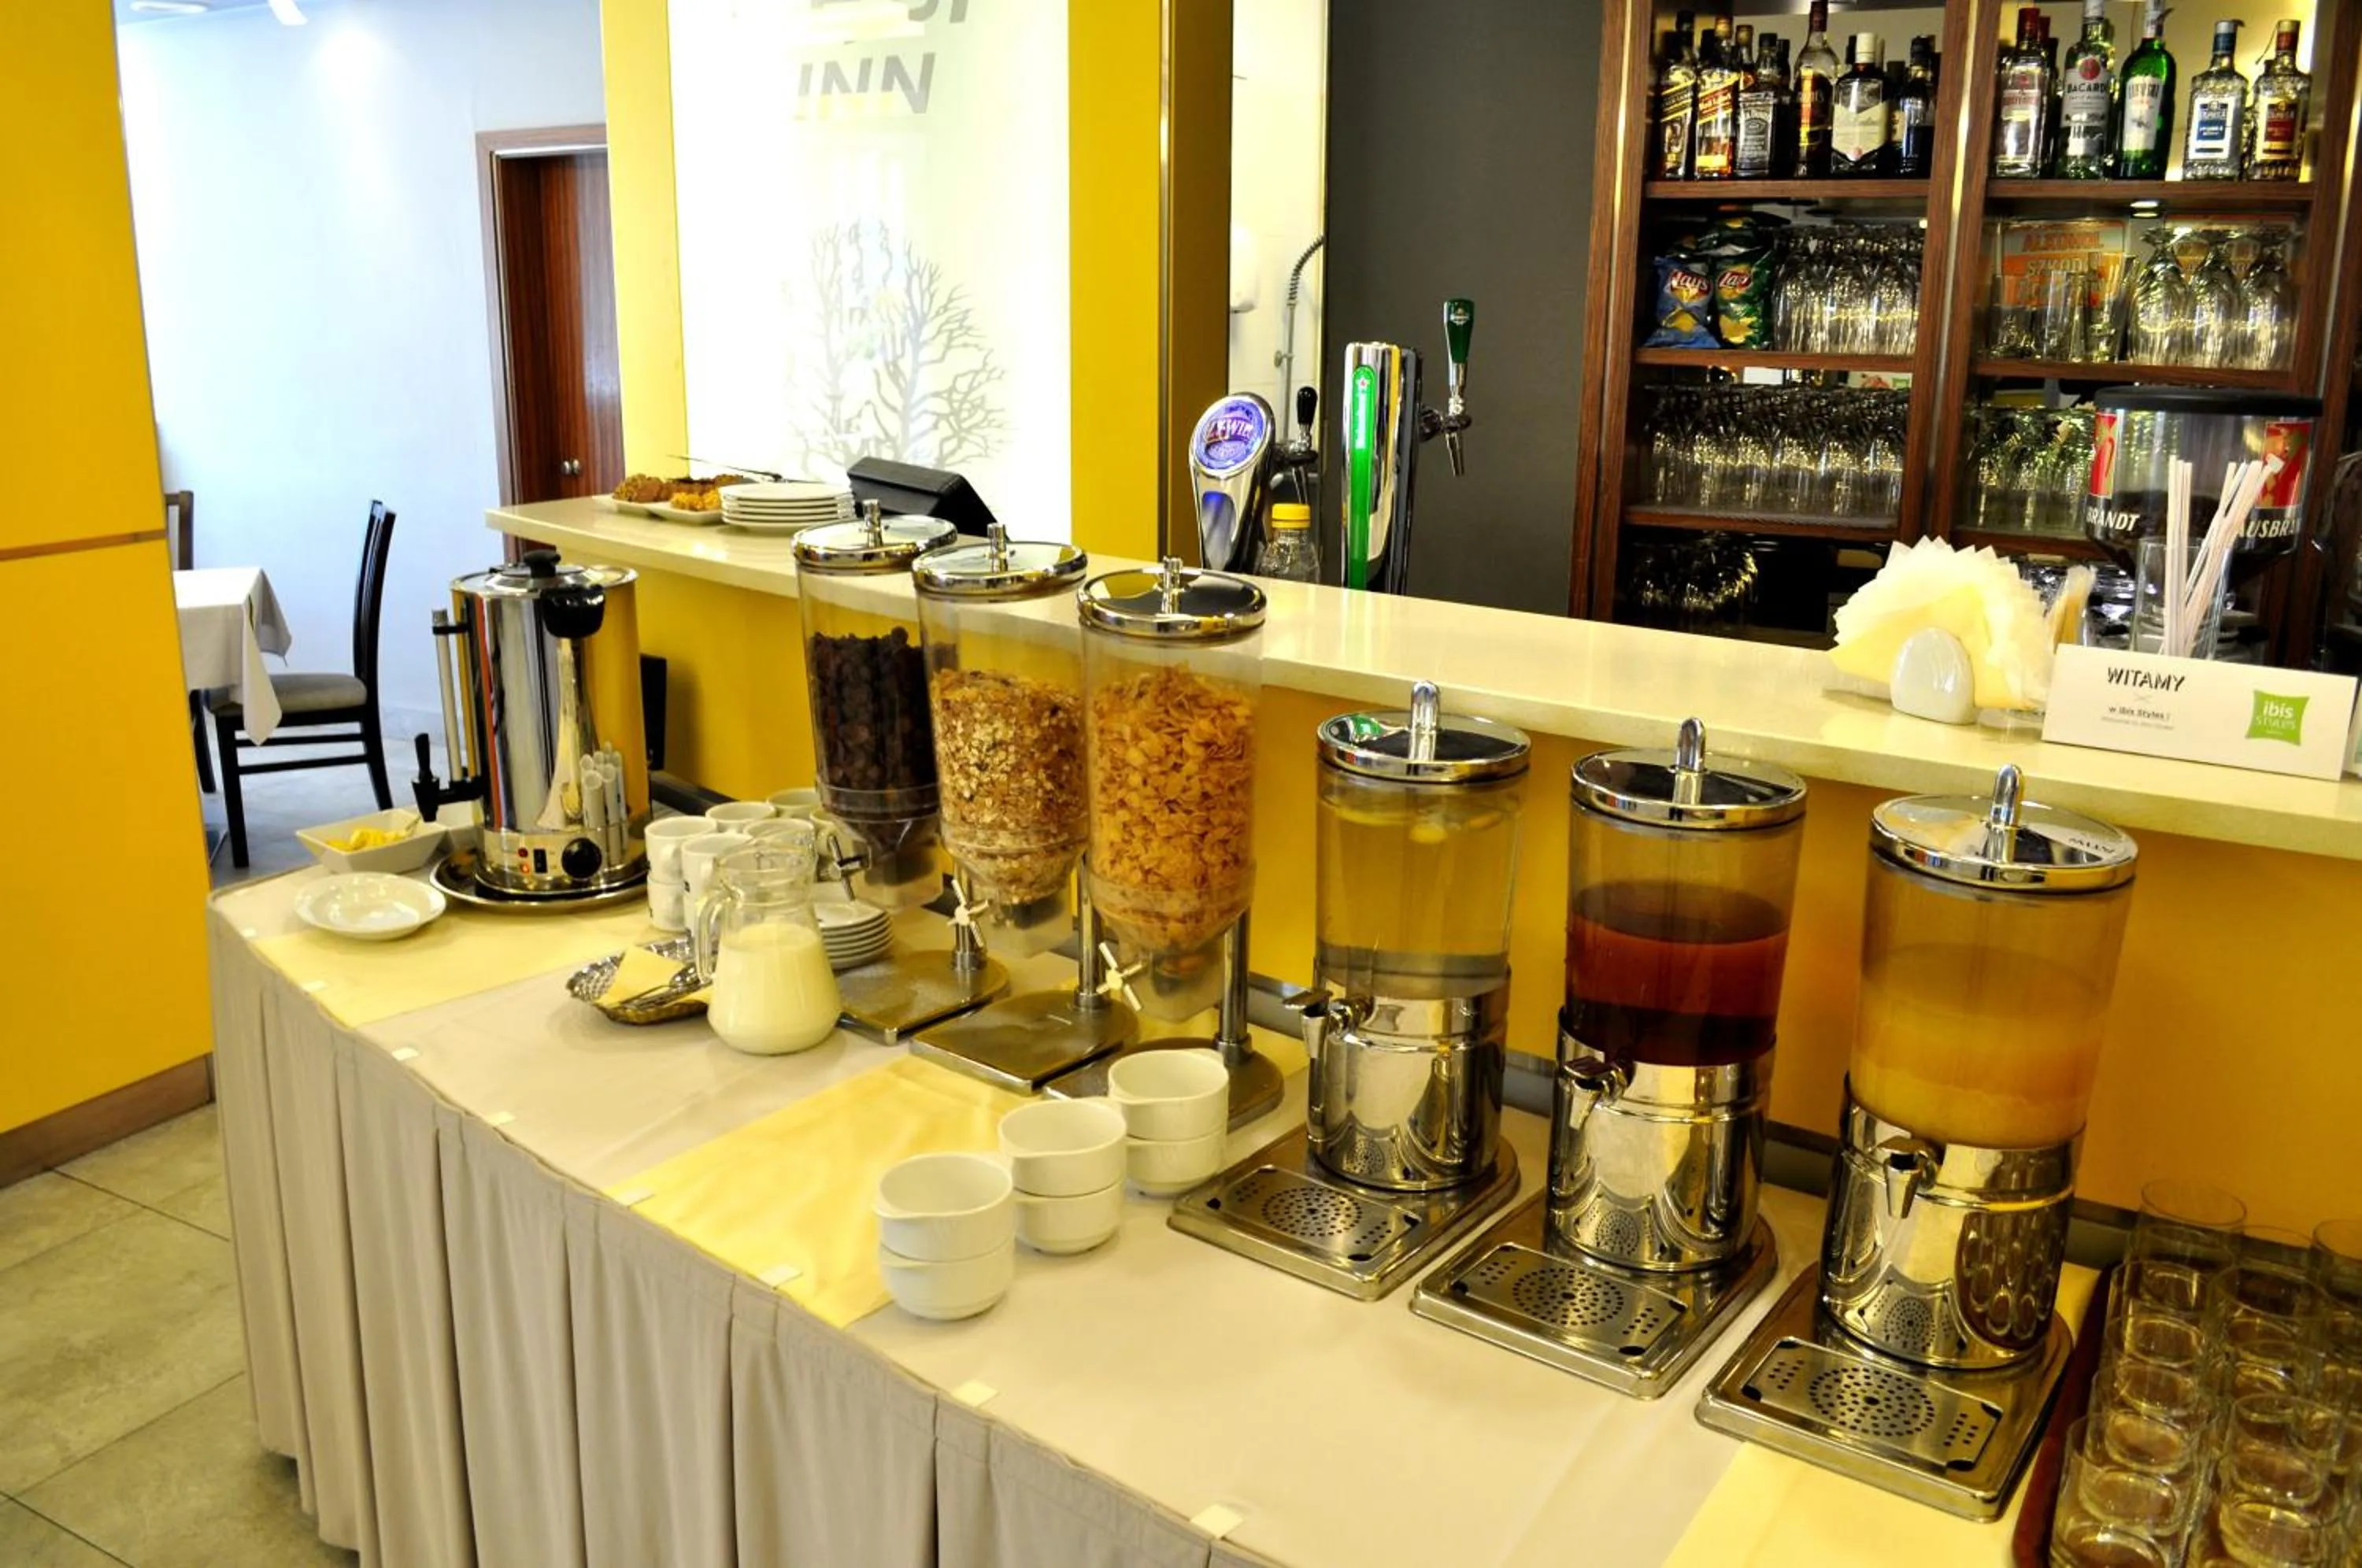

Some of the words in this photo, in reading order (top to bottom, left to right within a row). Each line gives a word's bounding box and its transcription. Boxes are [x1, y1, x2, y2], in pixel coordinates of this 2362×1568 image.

[794, 51, 936, 117] INN
[2066, 83, 2105, 94] BACARD
[2108, 667, 2186, 692] WITAMY
[2263, 700, 2294, 719] ibis
